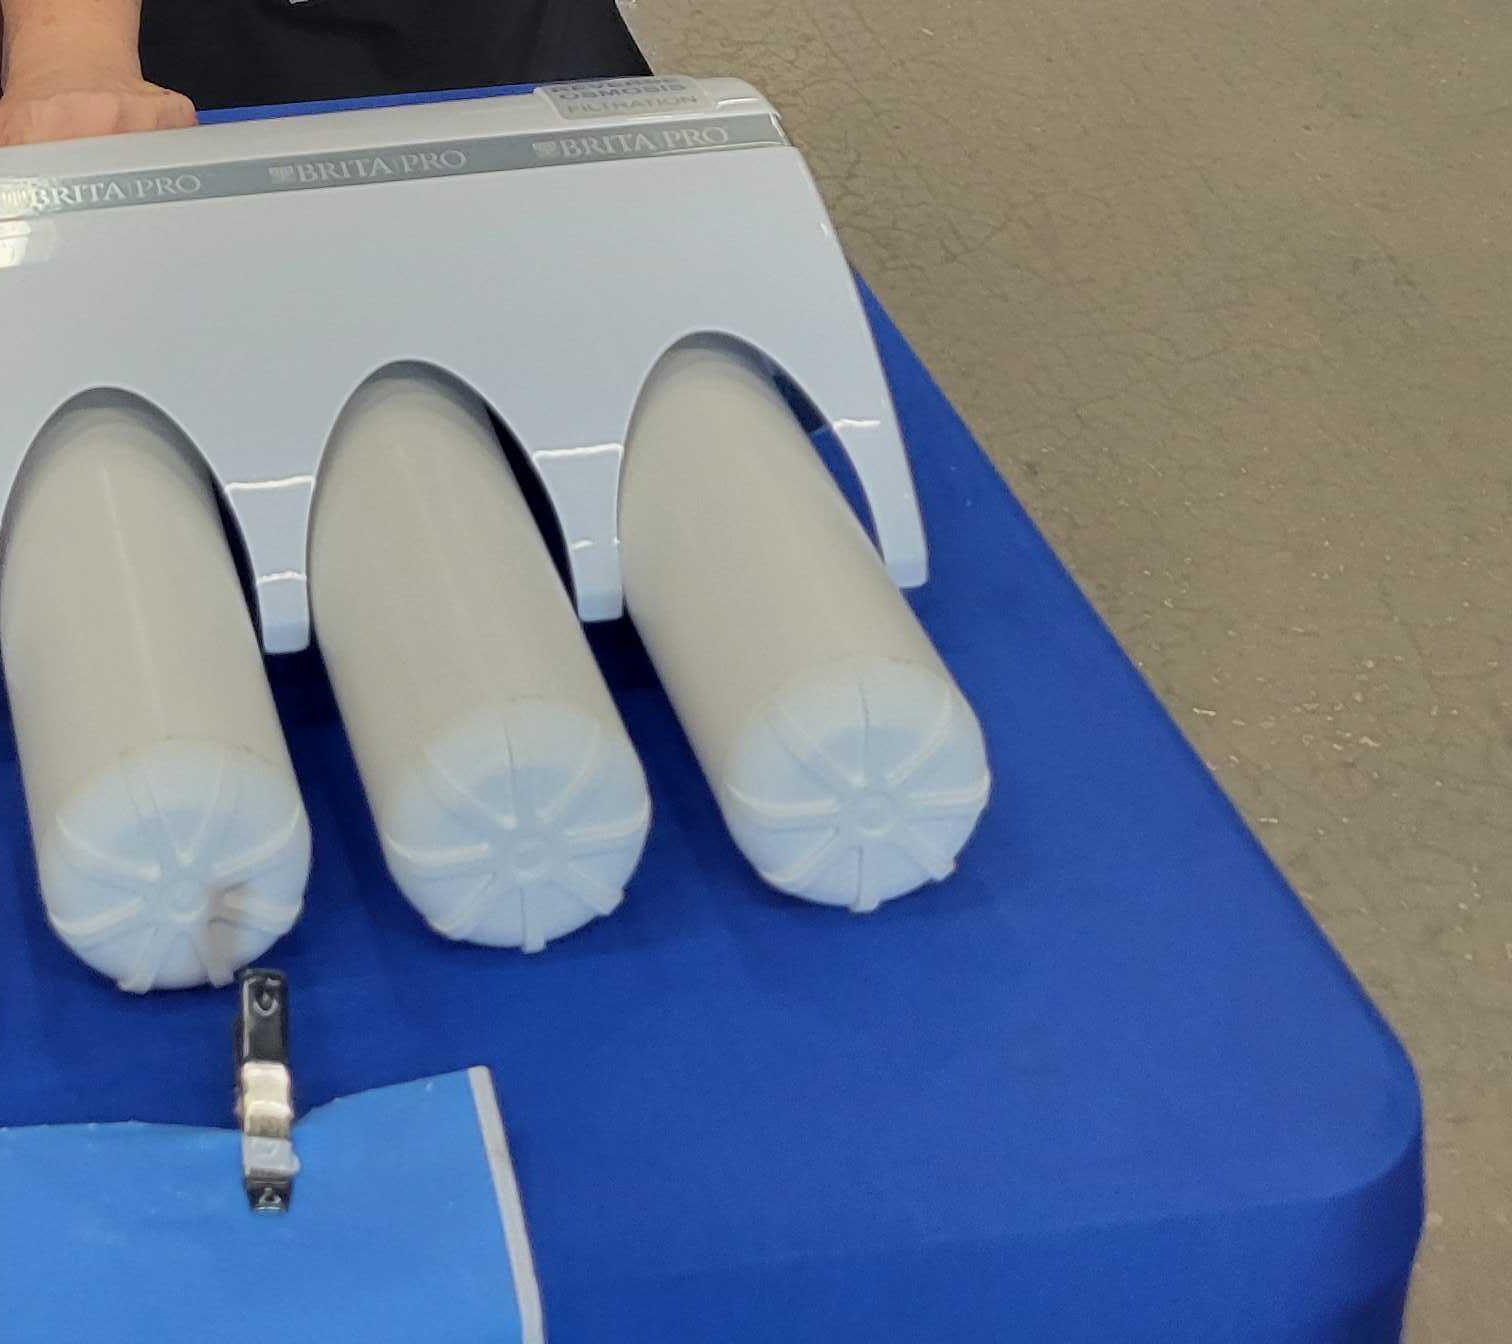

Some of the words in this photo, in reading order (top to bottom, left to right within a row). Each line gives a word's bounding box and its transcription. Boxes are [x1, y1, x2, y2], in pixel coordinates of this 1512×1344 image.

[559, 82, 688, 101] OSMOSIS
[567, 95, 698, 114] FILTRATION
[559, 132, 657, 158] BRITA
[662, 126, 729, 149] PRO
[296, 157, 394, 185] BRITA
[402, 149, 468, 173] PRO
[32, 182, 127, 210] BRITA
[137, 174, 202, 198] PRO
